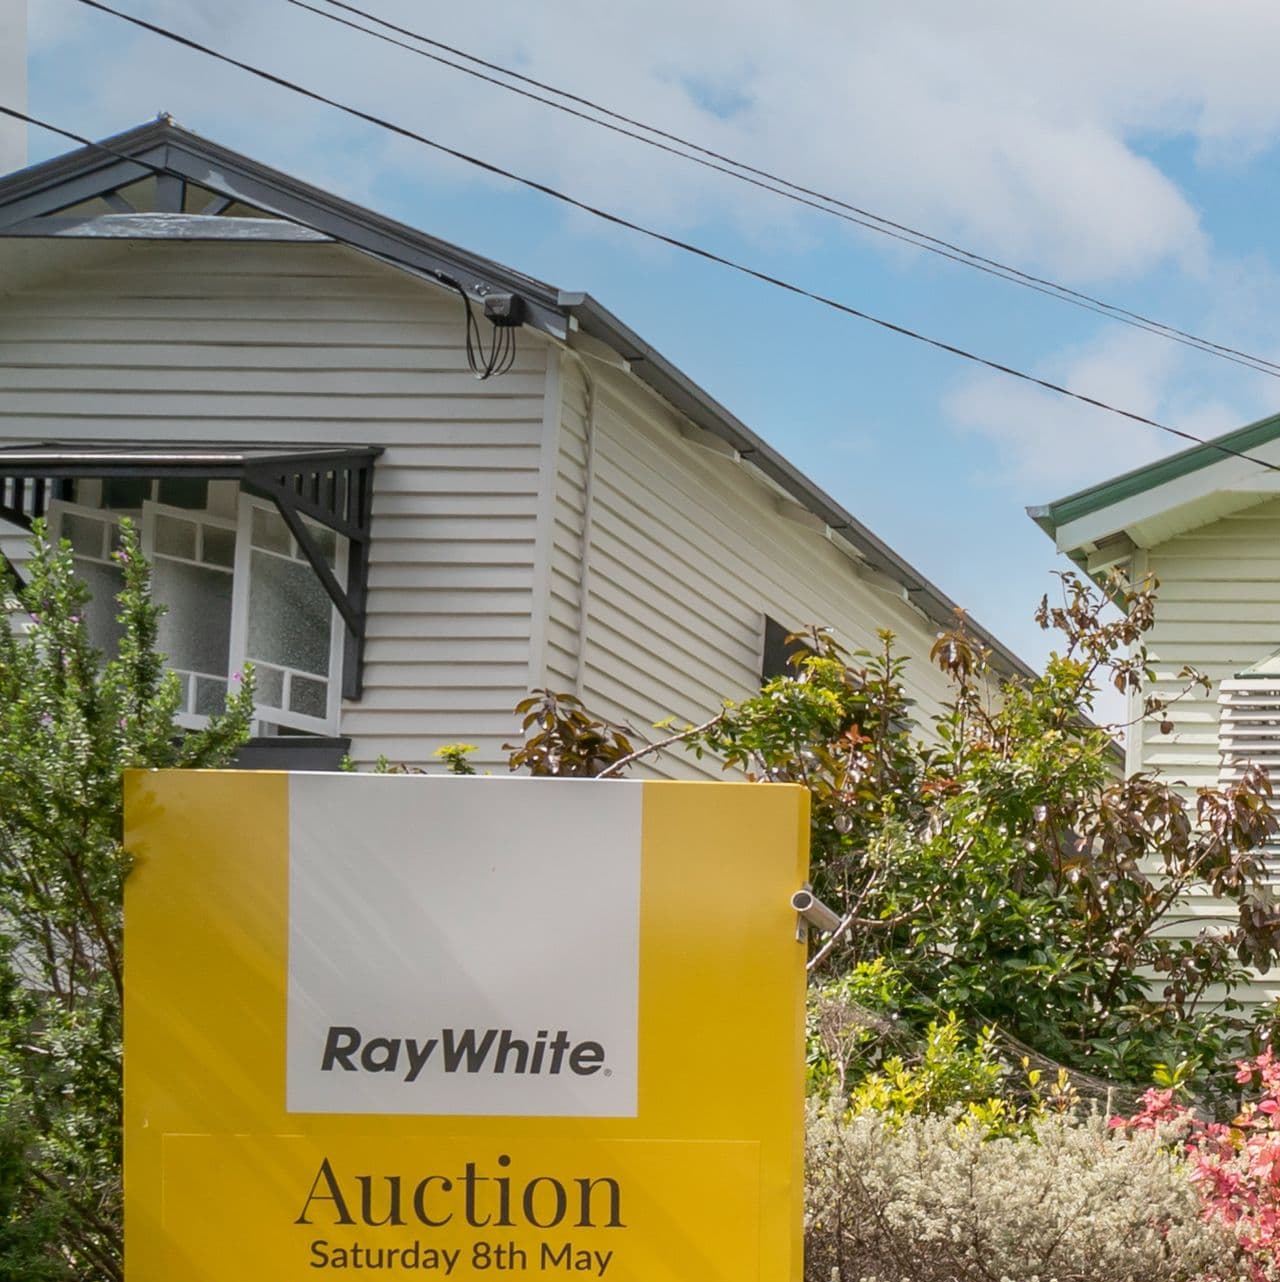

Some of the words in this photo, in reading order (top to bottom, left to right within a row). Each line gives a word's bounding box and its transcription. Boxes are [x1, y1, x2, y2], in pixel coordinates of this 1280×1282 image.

[294, 1154, 628, 1230] Auction
[309, 1239, 461, 1276] Saturday
[471, 1240, 527, 1271] 8th
[540, 1241, 614, 1278] May
